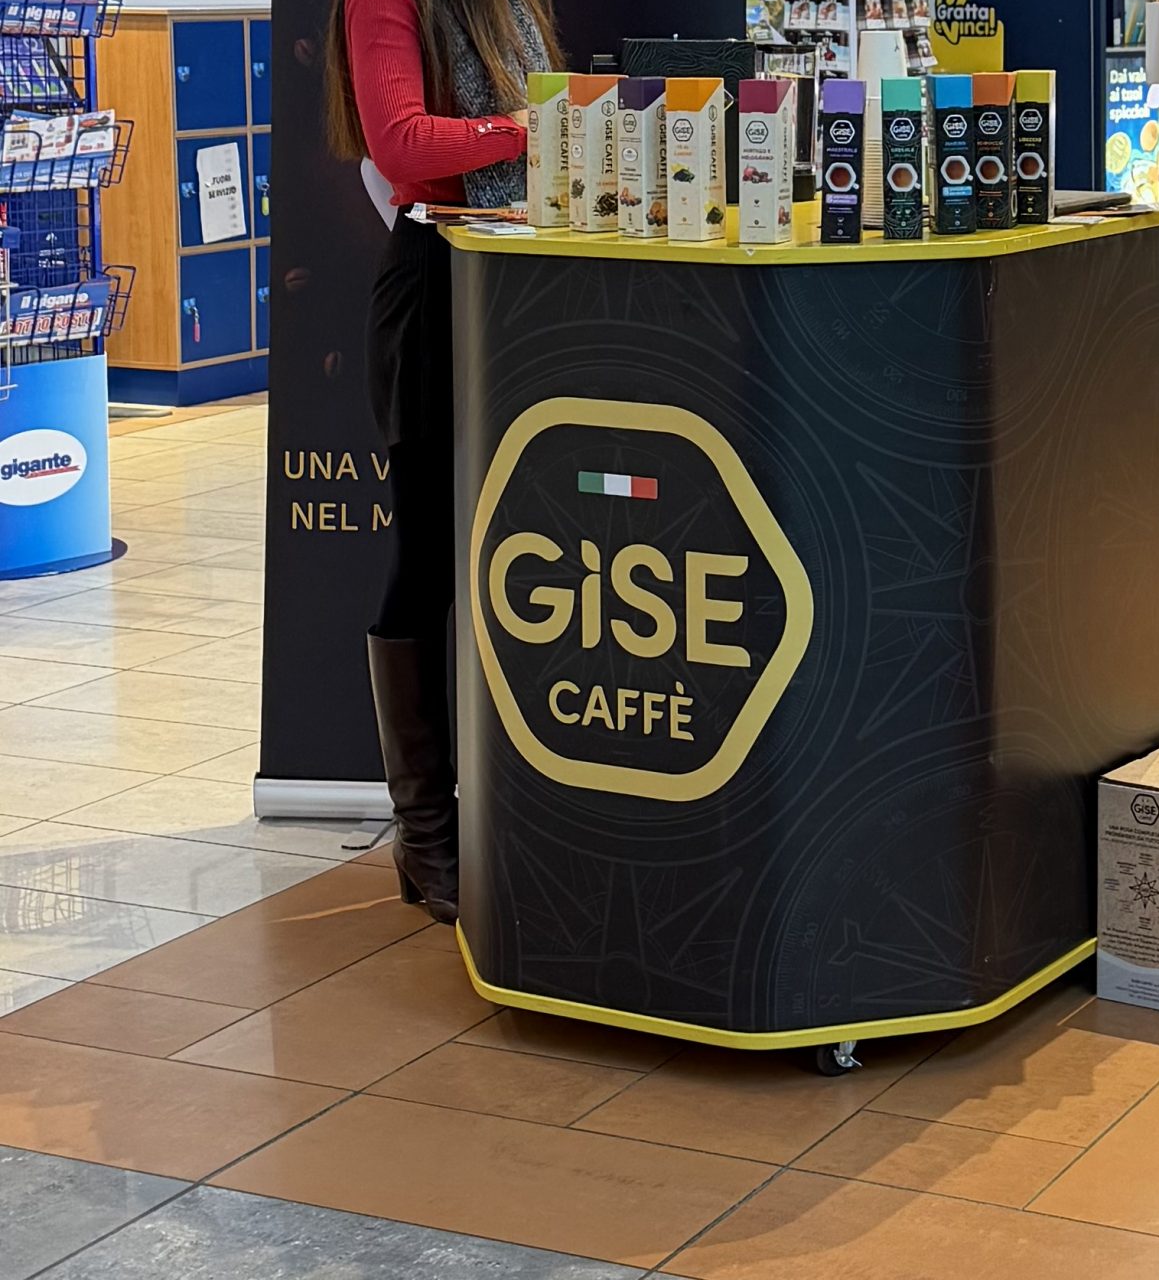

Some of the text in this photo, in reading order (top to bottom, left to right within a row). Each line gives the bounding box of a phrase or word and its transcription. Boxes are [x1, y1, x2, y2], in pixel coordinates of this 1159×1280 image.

[937, 3, 989, 20] Gratta
[1109, 69, 1128, 84] Dai
[1109, 85, 1143, 102] ai tuoi
[1, 452, 72, 481] gigante
[284, 450, 359, 480] UNA
[292, 502, 359, 532] NEL
[548, 680, 695, 741] CAFFÈ
